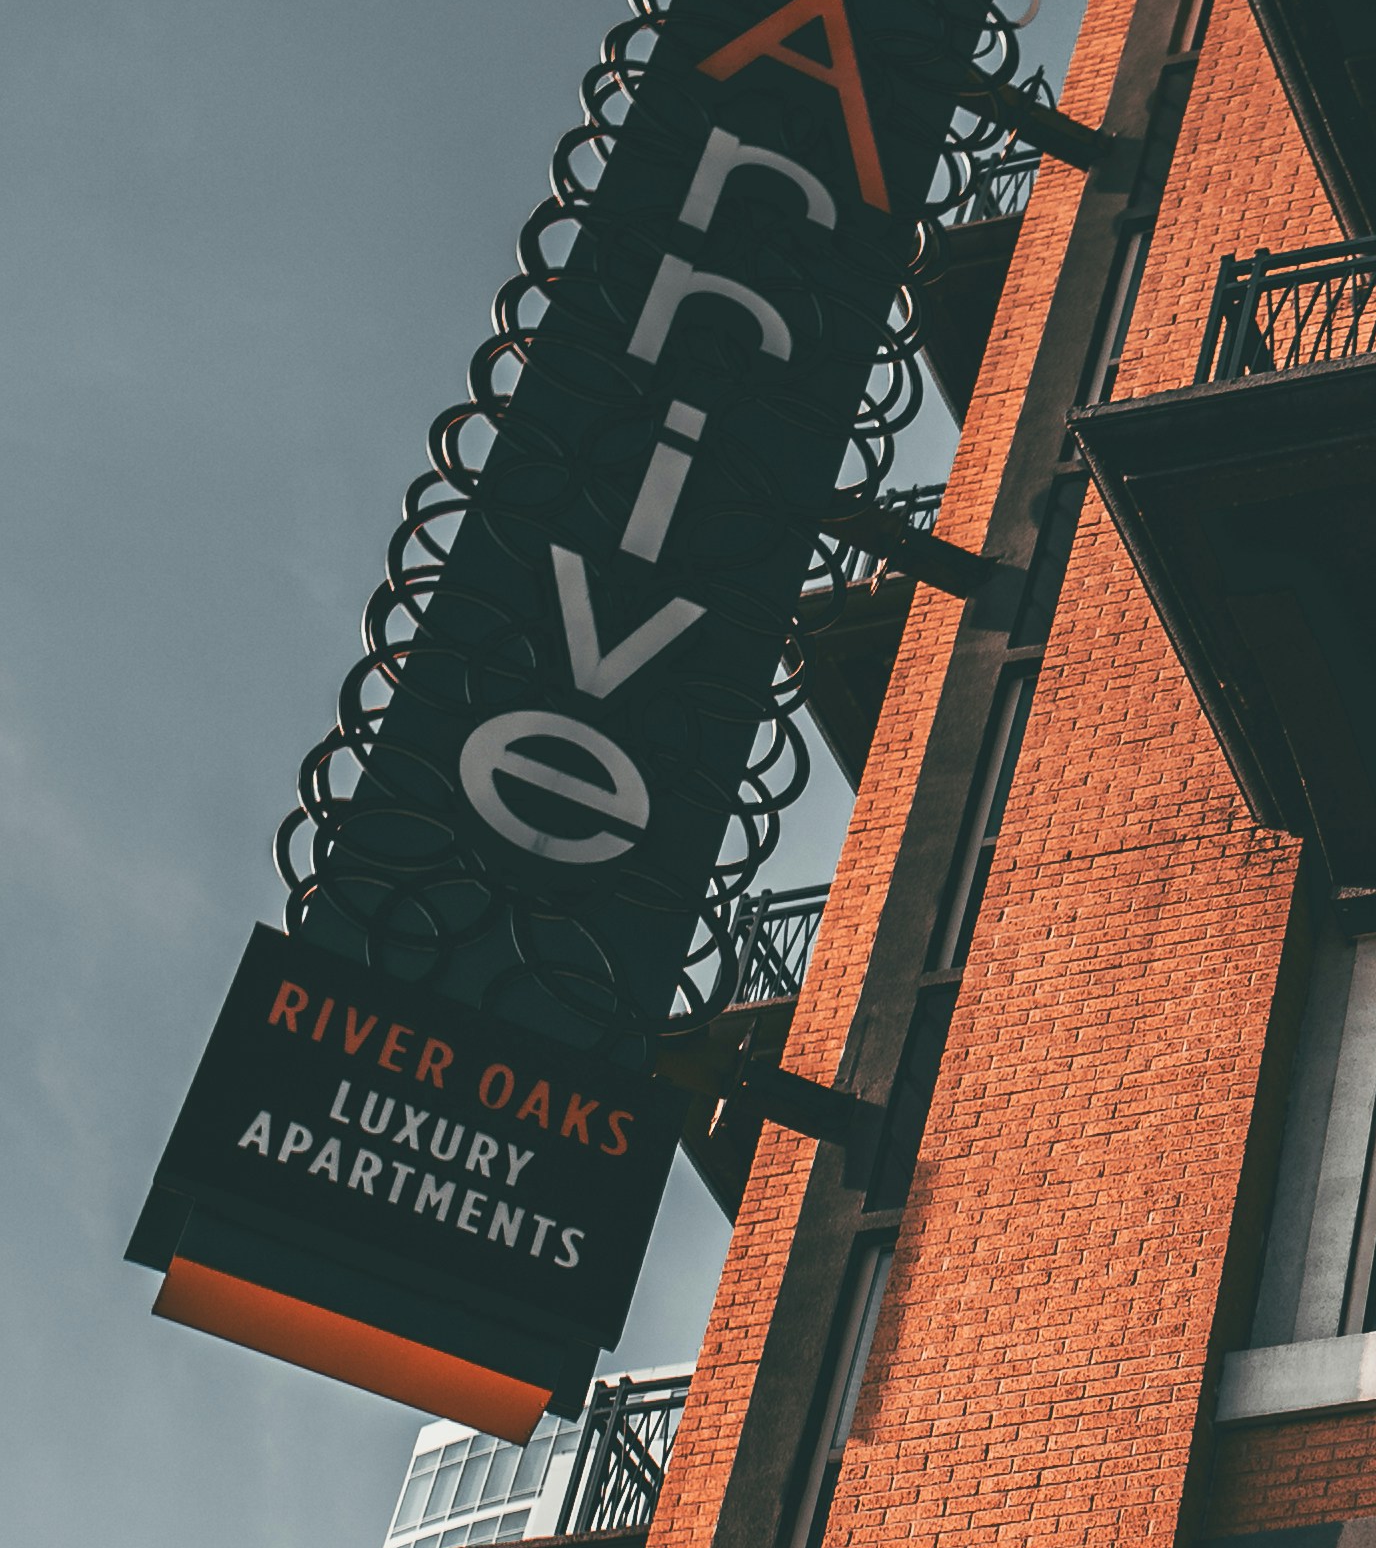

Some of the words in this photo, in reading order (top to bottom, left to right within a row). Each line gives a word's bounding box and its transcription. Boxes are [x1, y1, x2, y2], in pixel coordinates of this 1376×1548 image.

[267, 979, 455, 1090] RIVER
[478, 1063, 635, 1157] OAKS
[329, 1079, 536, 1187] LUXURY
[237, 1109, 587, 1269] APARTMENTS
